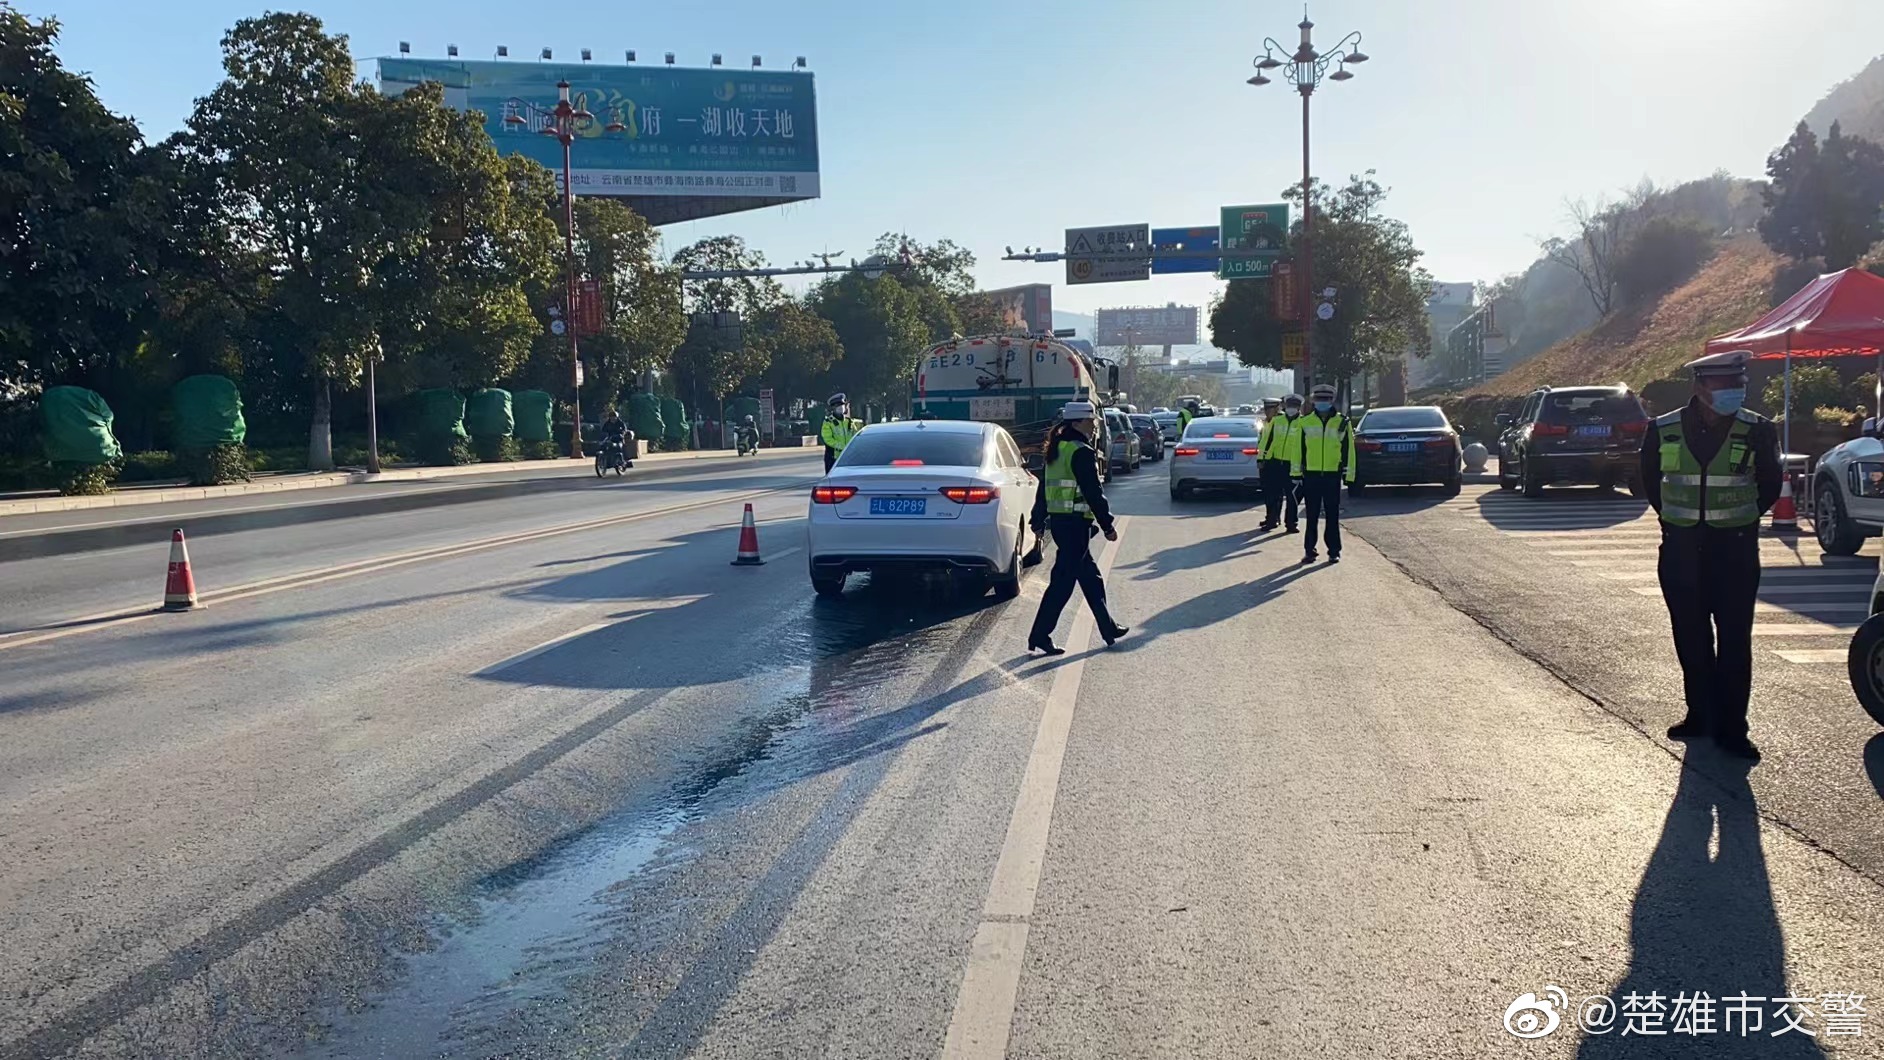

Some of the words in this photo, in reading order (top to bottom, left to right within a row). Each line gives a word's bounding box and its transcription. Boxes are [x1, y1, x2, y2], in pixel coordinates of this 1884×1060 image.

[677, 107, 795, 138] 一湖收天地
[1097, 230, 1145, 246] 收费站入口
[1077, 262, 1089, 274] 40
[1227, 262, 1242, 272] 入口
